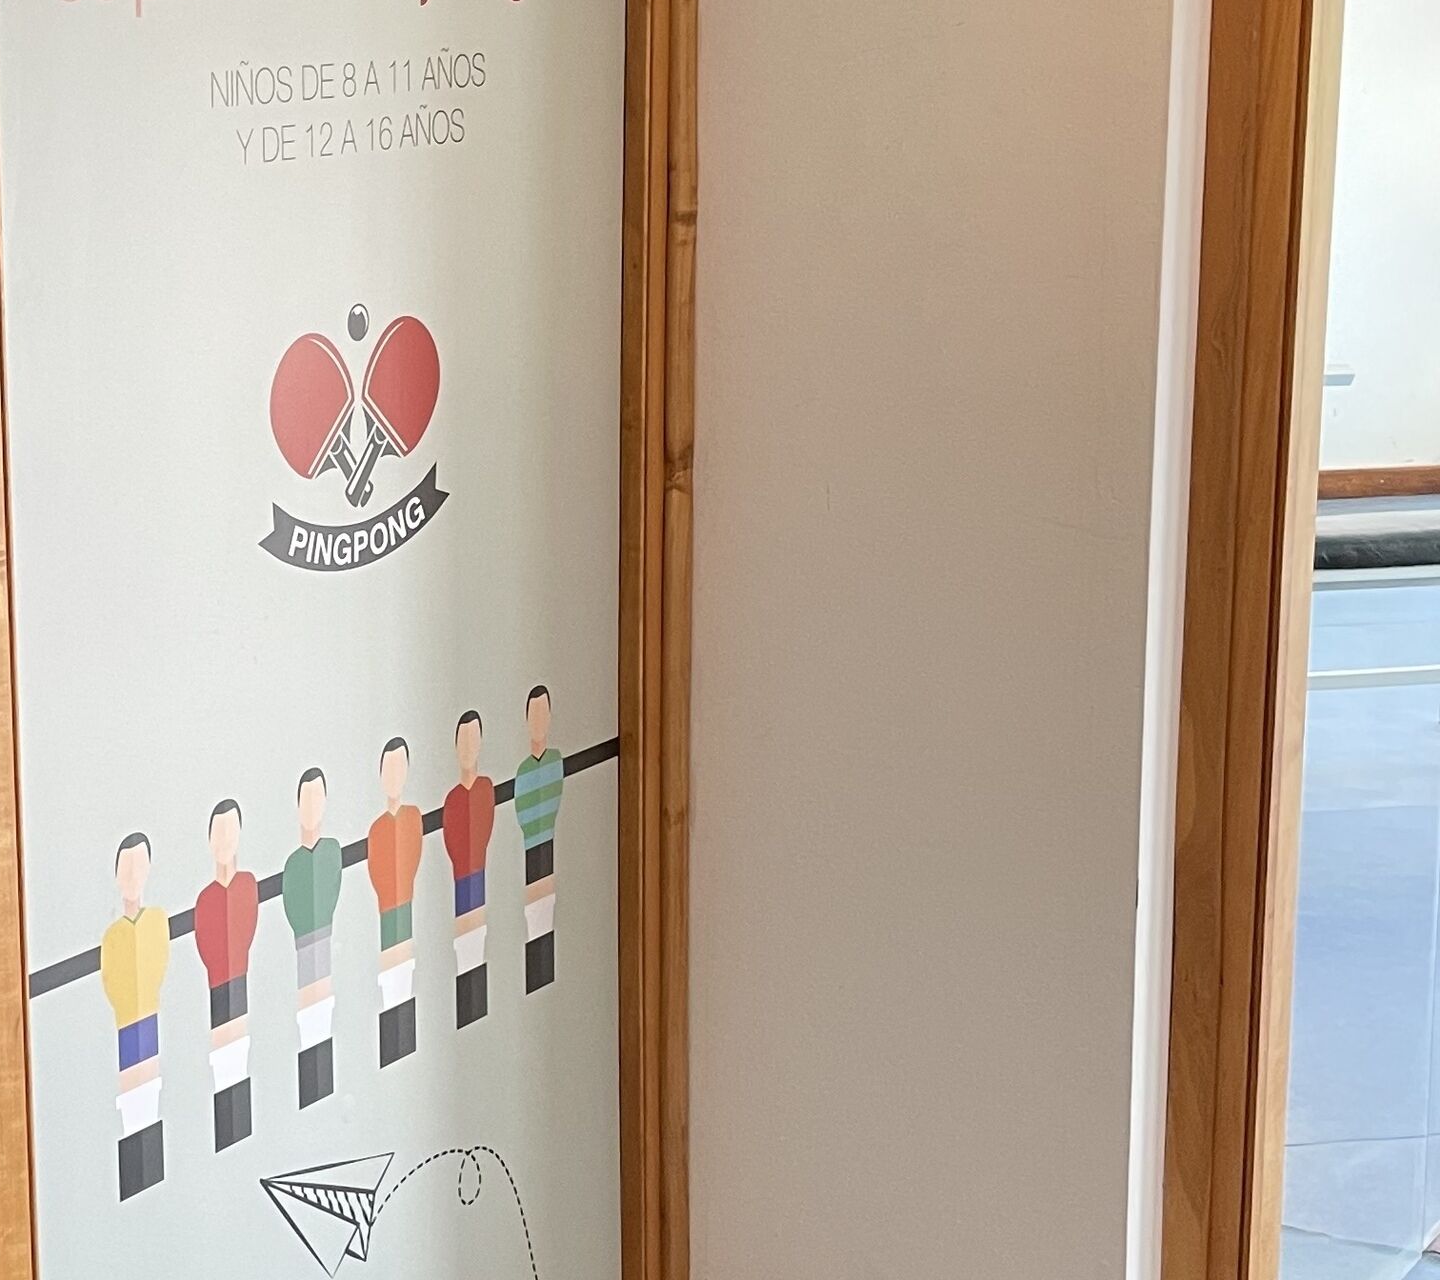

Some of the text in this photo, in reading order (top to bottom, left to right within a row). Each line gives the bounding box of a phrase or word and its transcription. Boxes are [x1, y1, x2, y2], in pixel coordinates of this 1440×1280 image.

[210, 47, 487, 108] NIÑOS DE 8 A 11 AÑOS
[235, 105, 466, 166] Y DE 12 A 16 AÑOS
[287, 496, 427, 566] PINGPONG
